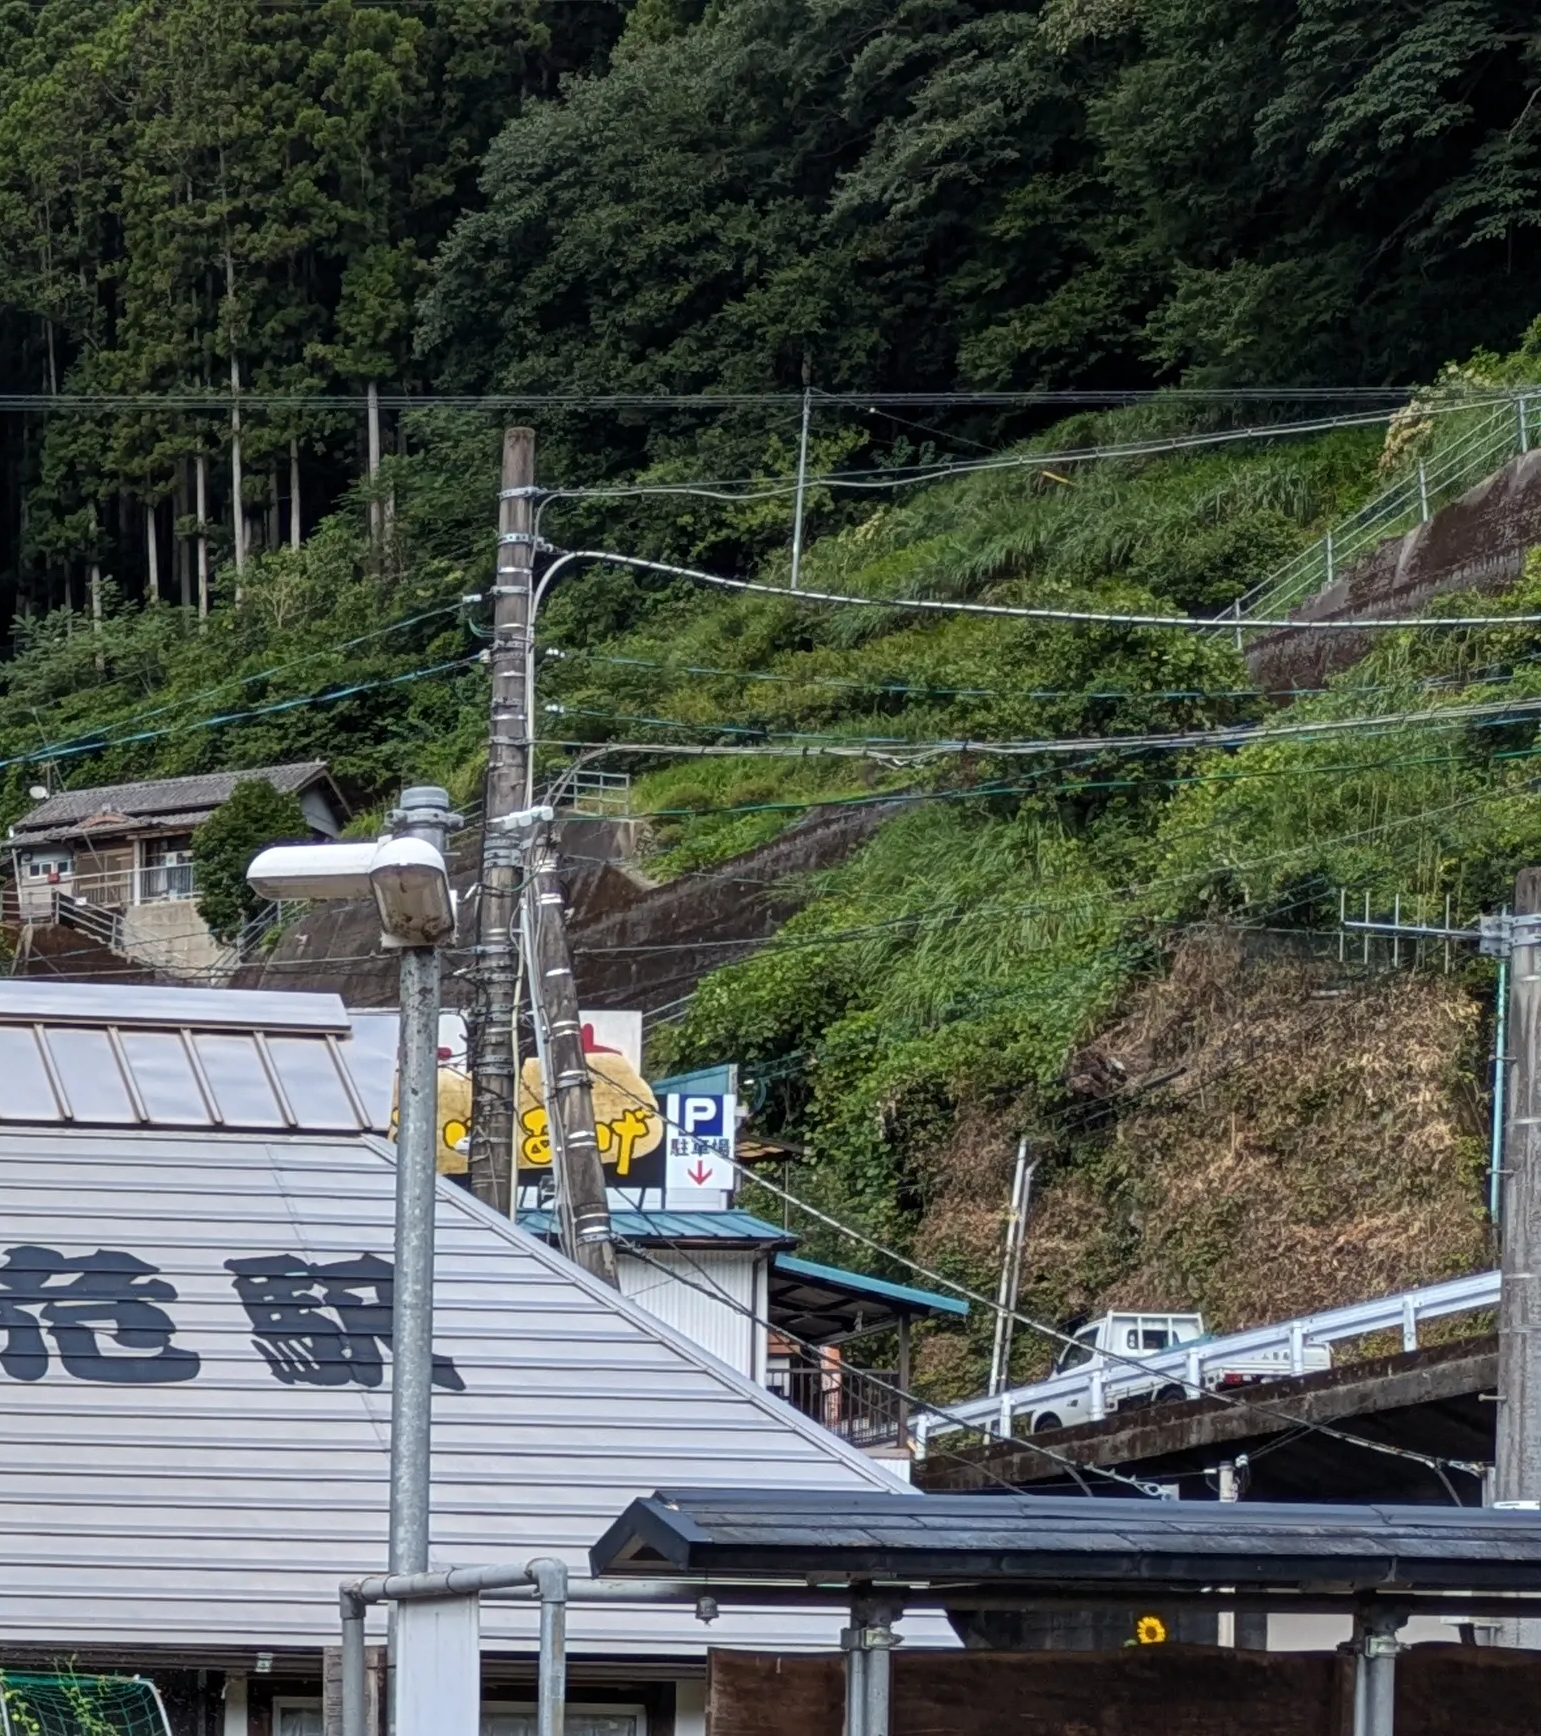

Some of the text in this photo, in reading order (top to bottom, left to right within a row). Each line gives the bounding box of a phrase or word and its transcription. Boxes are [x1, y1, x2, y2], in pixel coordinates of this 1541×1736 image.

[684, 1097, 717, 1133] P
[670, 1138, 730, 1158] 駐車場
